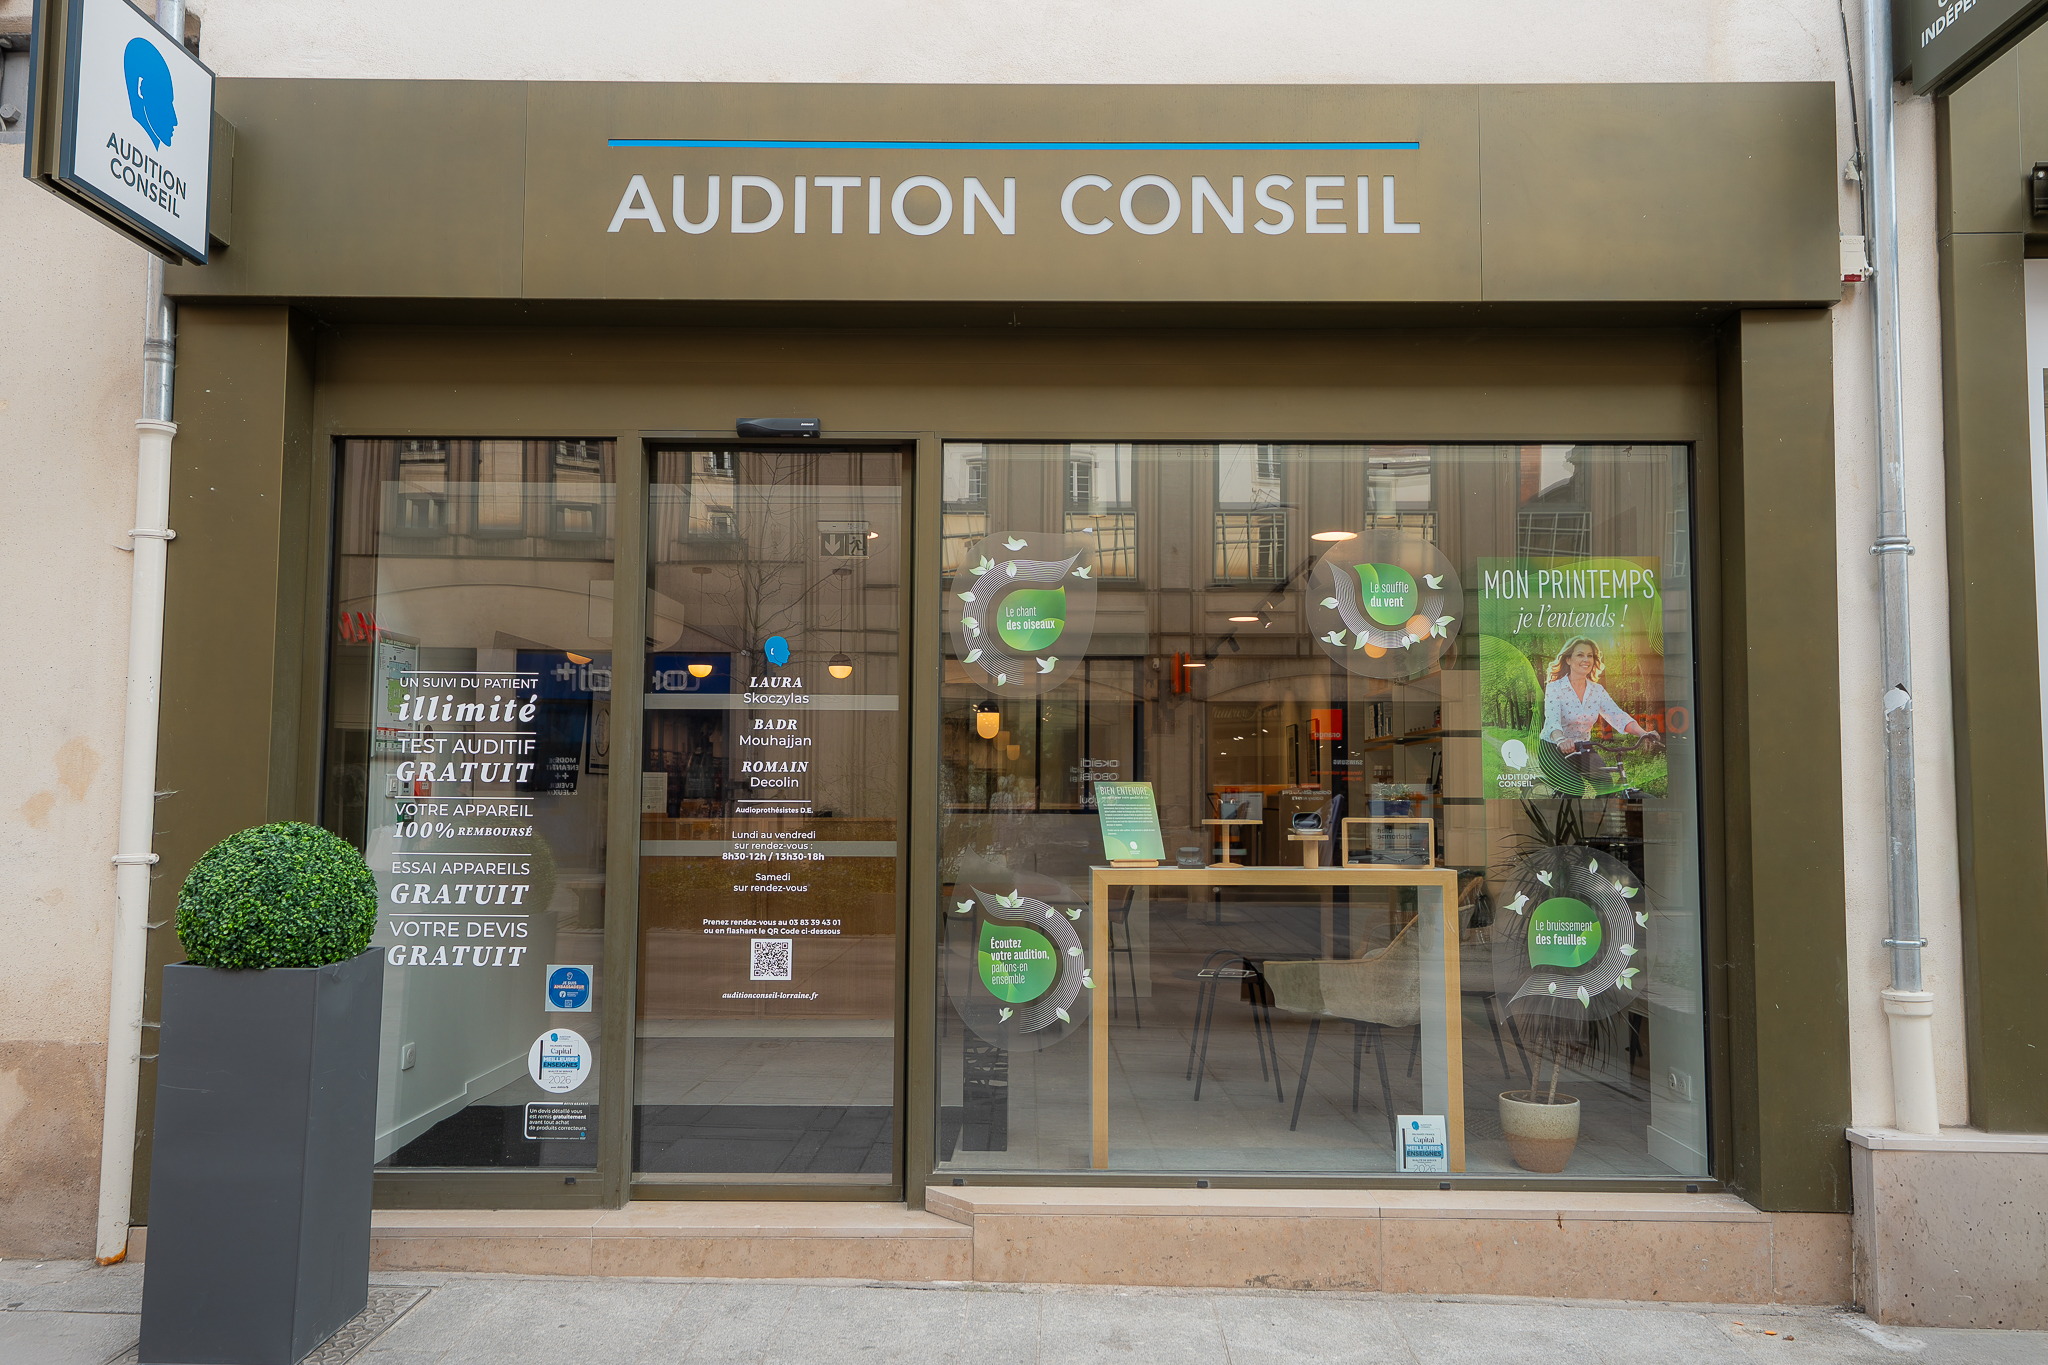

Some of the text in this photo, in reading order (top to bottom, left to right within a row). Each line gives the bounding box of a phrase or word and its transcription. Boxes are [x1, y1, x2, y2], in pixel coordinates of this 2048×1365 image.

[106, 132, 186, 200] AUDITION
[110, 157, 180, 218] CONSEIL
[607, 174, 1421, 236] AUDITION CONSEIL
[1370, 582, 1409, 593] Le souffle
[1485, 569, 1655, 599] MON PRINTEMPS
[1370, 596, 1404, 607] du vent
[1006, 606, 1037, 617] Le chant
[1006, 618, 1056, 630] des oiseaux
[1513, 606, 1532, 634] je
[1620, 604, 1628, 628] !
[400, 677, 539, 689] UN SUIVI DU PATIENT
[749, 677, 802, 688] LAURA
[743, 692, 810, 706] Skoczylas
[398, 694, 538, 723] illimité
[753, 719, 798, 730] BADR
[398, 738, 448, 754] TEST
[452, 739, 537, 755] AUDITIF
[739, 735, 812, 748] Mouhajjan
[396, 761, 534, 783] GRATUIT
[741, 761, 809, 773] ROMAIN
[750, 777, 799, 788] Decolin
[1496, 773, 1536, 781] AUDITION
[1498, 780, 1534, 788] CONSEIL
[1100, 786, 1151, 796] BIEN ENTENDRE,
[395, 803, 533, 817] VOTRE APPAREIL
[735, 806, 799, 815] Audioprothésistes
[393, 821, 533, 839] 100% REMBOURSÉ
[731, 831, 758, 839] Lundi
[774, 831, 816, 839] vendredi
[751, 842, 808, 850] rendez-vous
[722, 852, 825, 861] 8h30-12h / 13h30-18h
[392, 861, 530, 876] ESSAI APPAREILS
[755, 873, 791, 881] Samedi
[750, 883, 808, 892] rendez-vous
[390, 883, 529, 905] GRATUIT
[389, 921, 528, 938] VOTRE DEVIS
[767, 928, 779, 936] QR
[1535, 920, 1593, 932] Le bruissement
[990, 936, 1021, 949] Écoutez
[1535, 934, 1587, 945] des feuilles
[388, 944, 527, 967] GRATUIT
[991, 949, 1050, 961] votre audition,
[991, 962, 1028, 975] parlons-en
[991, 974, 1025, 985] ensemble
[722, 992, 818, 1000] auditionconseil-lorraine.fr
[549, 1076, 571, 1084] 2026
[1414, 1164, 1437, 1172] 2026
